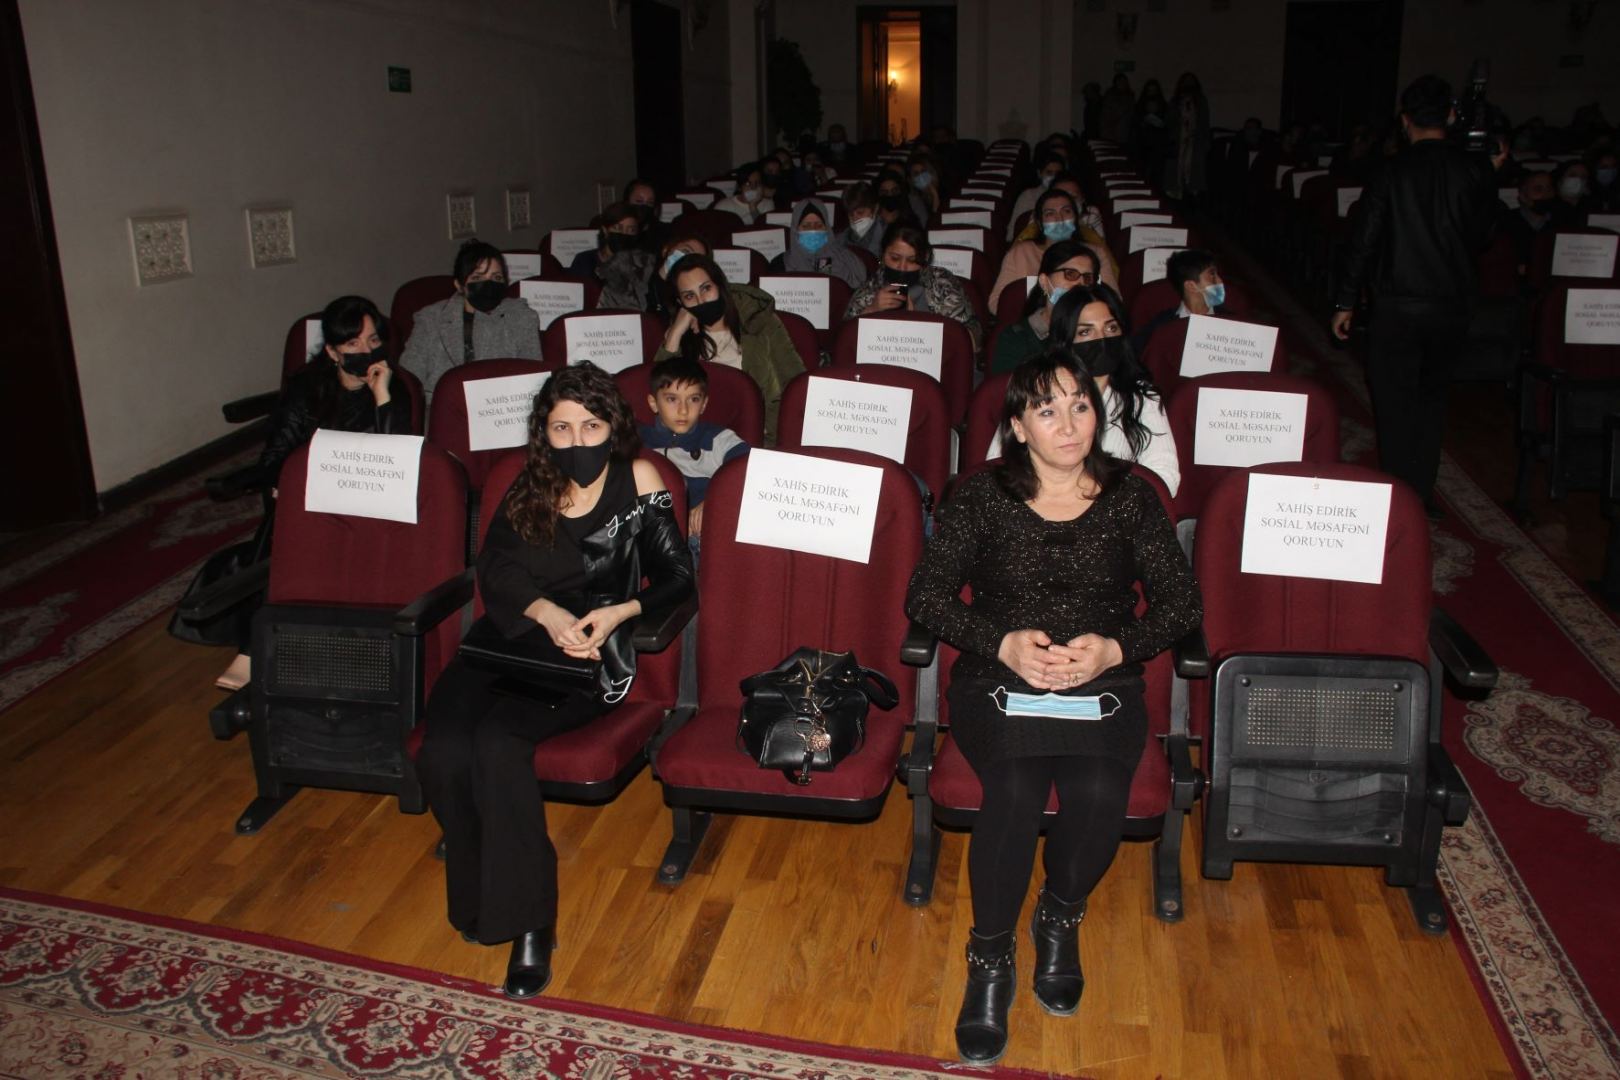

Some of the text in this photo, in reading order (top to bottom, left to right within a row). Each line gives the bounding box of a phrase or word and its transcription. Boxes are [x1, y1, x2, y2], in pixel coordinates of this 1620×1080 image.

[817, 409, 848, 420] SOSİAL
[833, 424, 878, 435] QORUYUN
[1225, 434, 1272, 444] QORUYUN
[320, 463, 352, 475] SOSİAL
[337, 479, 385, 492] QORUYUN
[758, 490, 860, 516] SOSİAL MƏSAFƏNİ
[1276, 502, 1358, 518] XAHİŞ EDİRİK
[778, 510, 835, 527] QORUYUN
[1260, 517, 1370, 535] SOSİAL MƏSAFƏNİ
[1283, 535, 1344, 549] QORUYUN
